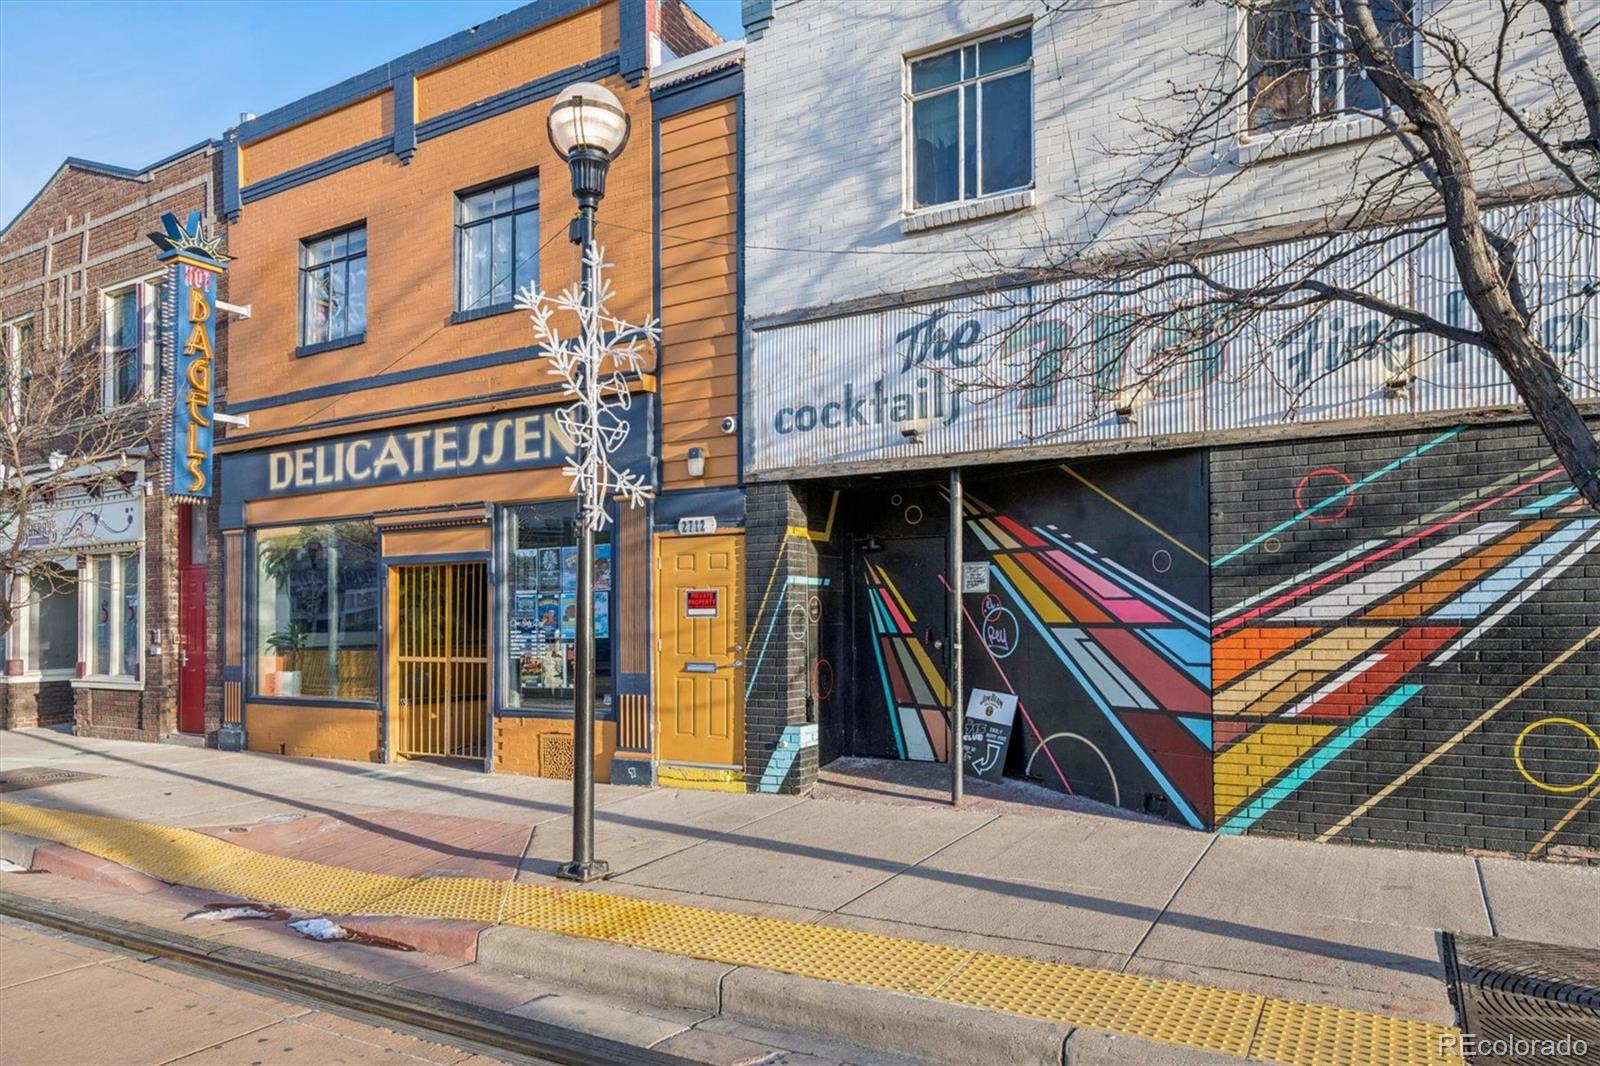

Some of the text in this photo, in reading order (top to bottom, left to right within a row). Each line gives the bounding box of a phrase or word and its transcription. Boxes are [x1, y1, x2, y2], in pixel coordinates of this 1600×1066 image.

[896, 308, 982, 374] The
[269, 410, 577, 491] DELICATESSEN
[681, 520, 706, 533] 2712
[690, 590, 714, 600] PRIVATE
[688, 599, 716, 608] PROPERTY
